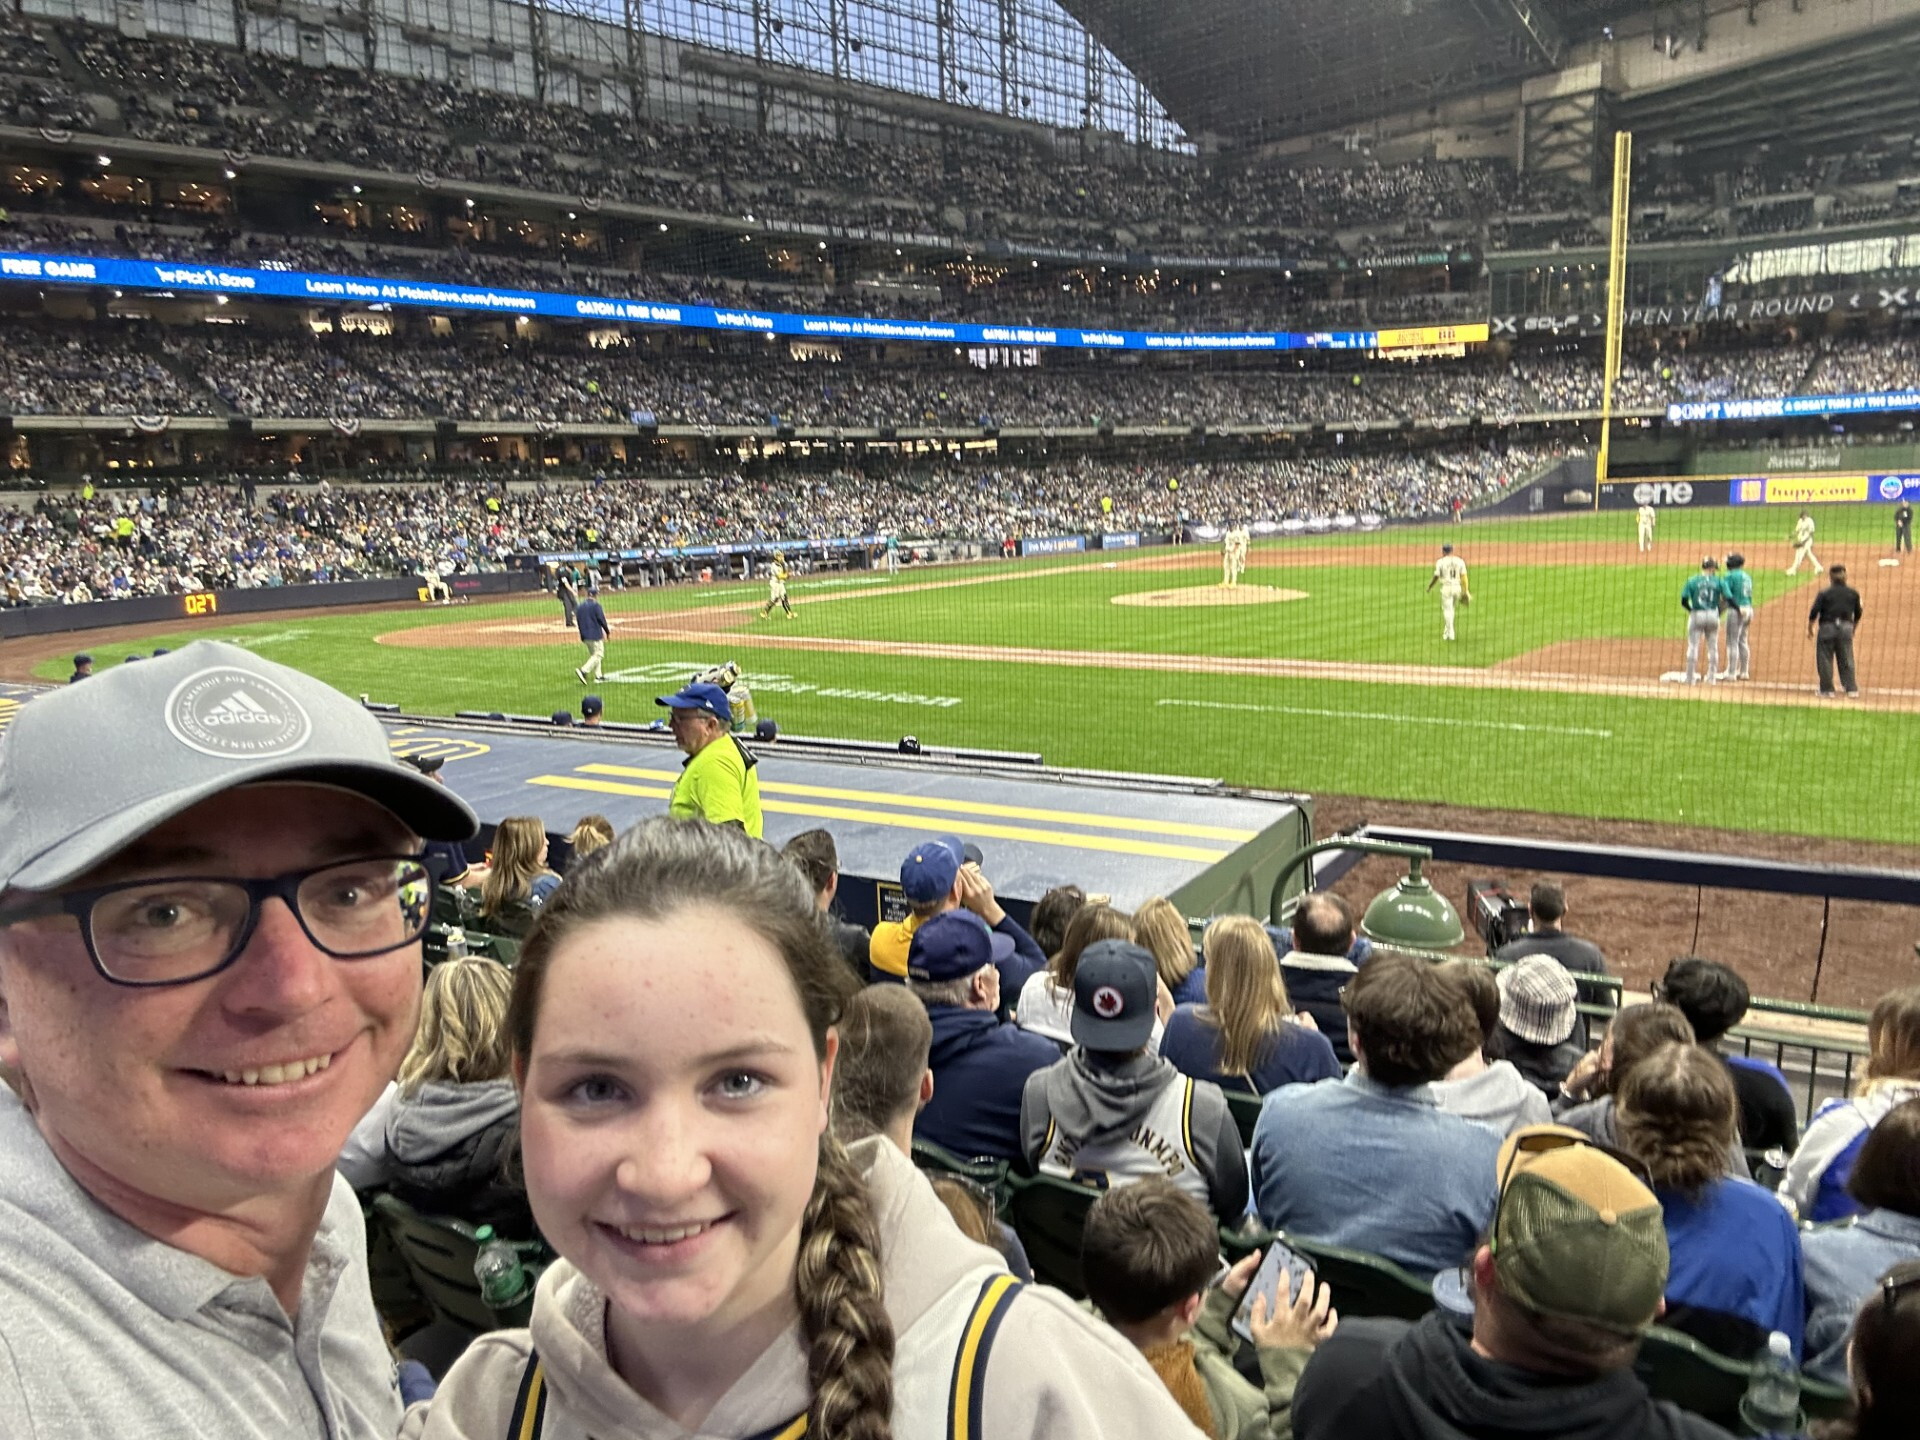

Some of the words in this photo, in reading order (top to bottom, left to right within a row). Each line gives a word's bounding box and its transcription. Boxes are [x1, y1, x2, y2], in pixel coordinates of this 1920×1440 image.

[1, 258, 42, 275] FREE
[44, 262, 97, 279] GAME
[218, 273, 256, 288] Save
[305, 279, 345, 294] Learn
[346, 282, 379, 298] More
[381, 284, 397, 298] At
[576, 300, 615, 316] CATCH
[616, 305, 626, 317] A
[626, 304, 650, 319] FREE
[650, 307, 681, 322] GAME
[1623, 307, 1672, 325] PEN
[1750, 295, 1835, 319] ROUND
[803, 319, 829, 332] Learn
[829, 321, 851, 333] More
[1524, 315, 1580, 331] GOLF
[1669, 402, 1721, 420] DON'T
[1723, 400, 1784, 418] WRECK
[1633, 481, 1694, 505] one
[1771, 486, 1857, 502] hupy.com
[203, 710, 282, 726] adidas
